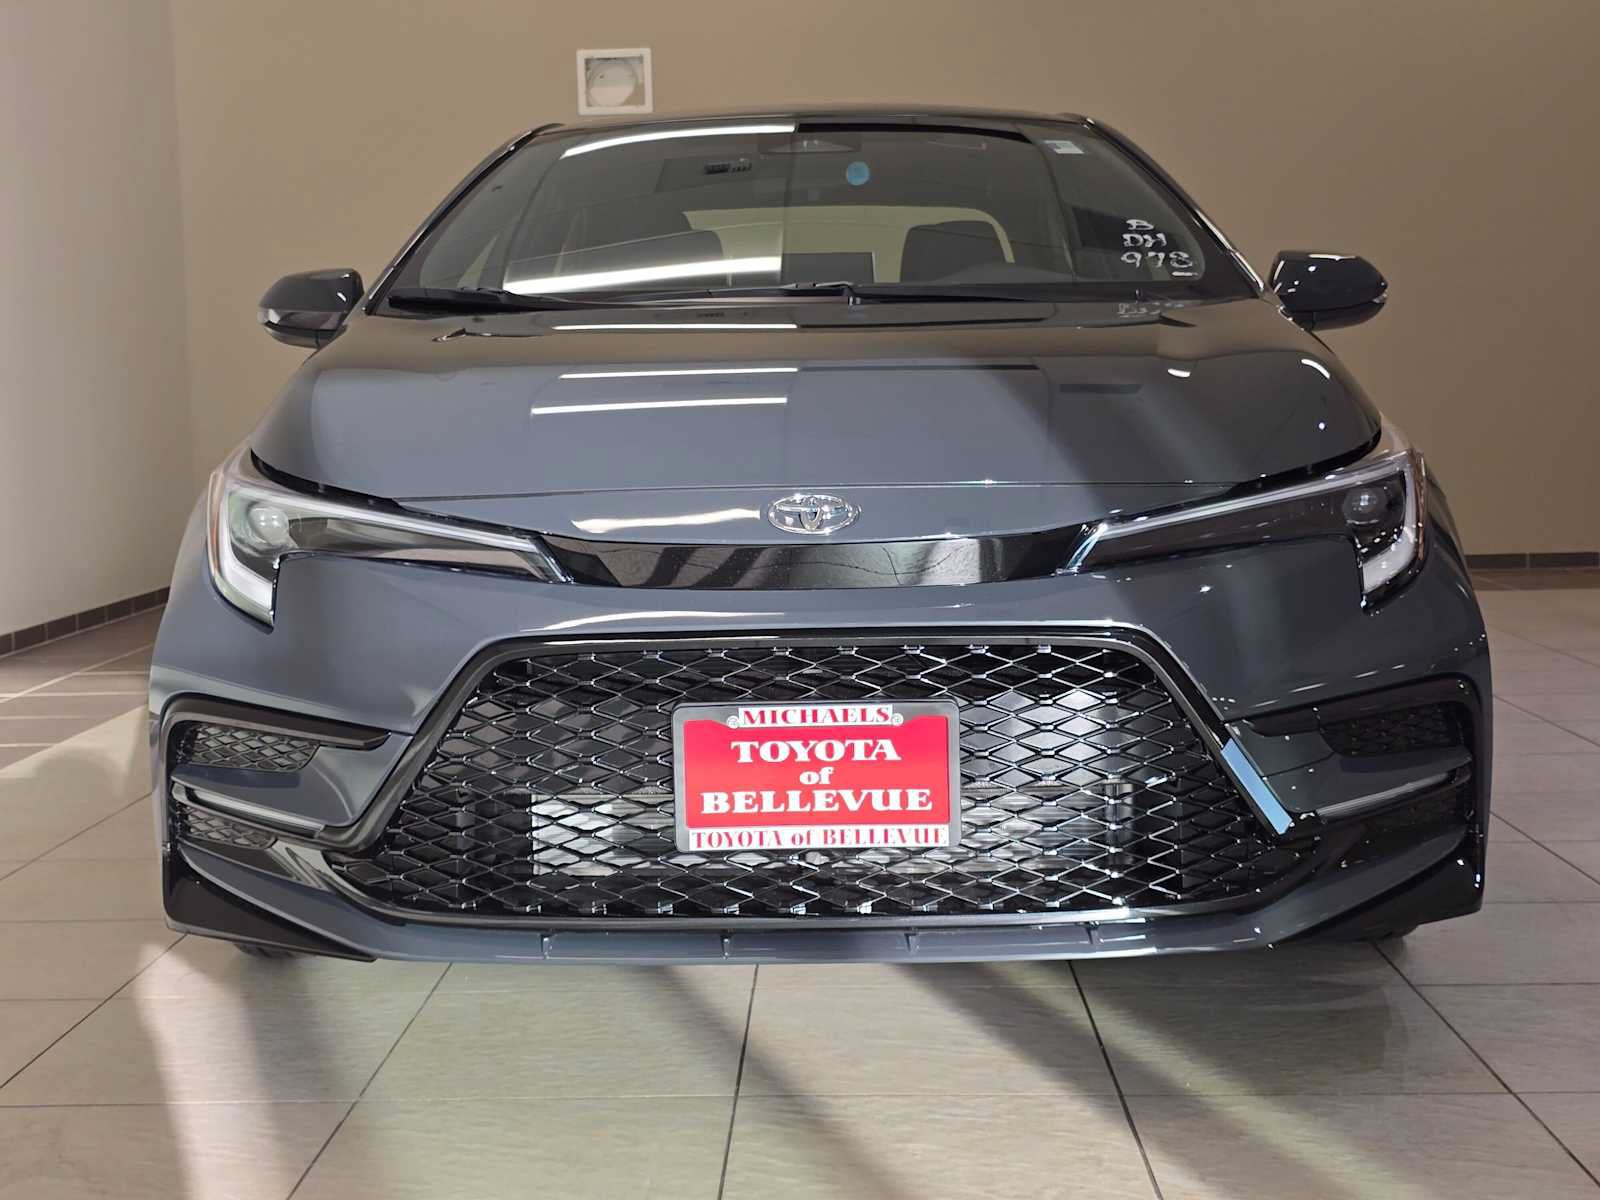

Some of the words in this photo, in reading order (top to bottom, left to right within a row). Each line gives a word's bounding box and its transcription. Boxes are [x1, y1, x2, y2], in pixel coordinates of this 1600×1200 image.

[1120, 251, 1193, 268] 978
[742, 707, 890, 725] MICHAELS
[731, 739, 902, 763] TOYOTA
[799, 767, 834, 785] of
[700, 789, 933, 815] BELLEVUE
[692, 830, 782, 849] TOYOTA
[791, 829, 813, 846] of
[823, 827, 946, 846] BELLEVUE
